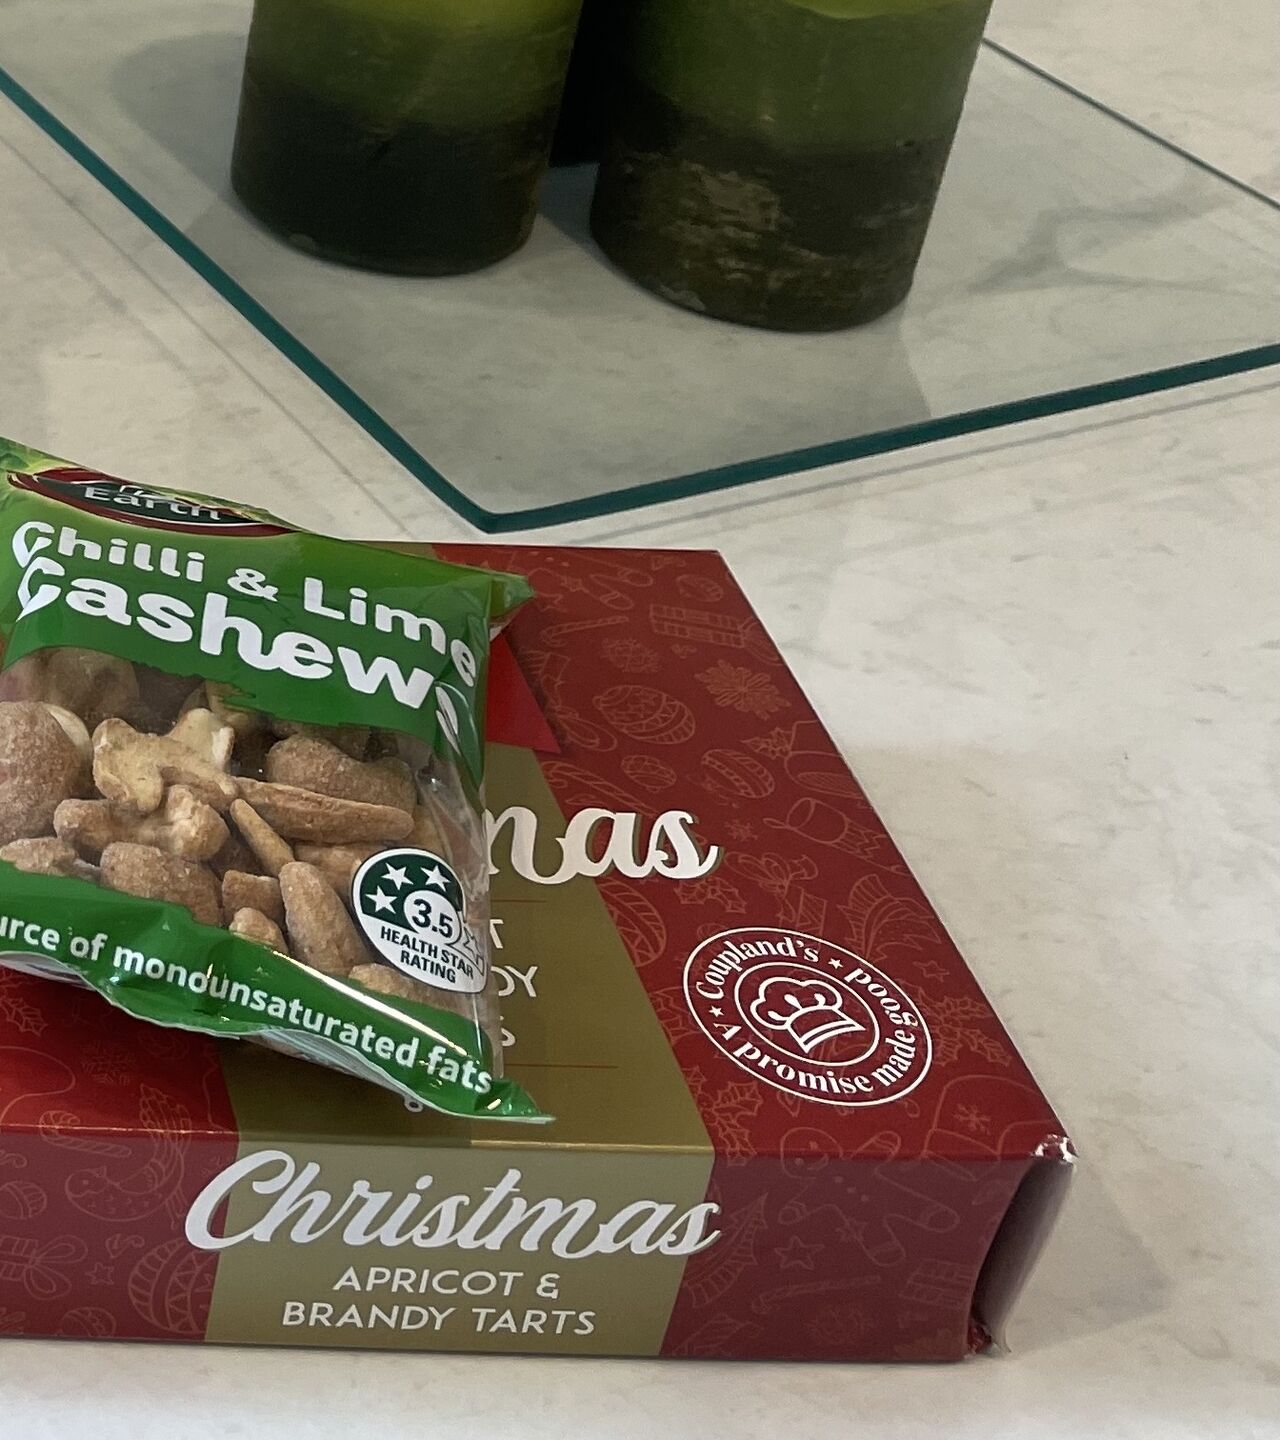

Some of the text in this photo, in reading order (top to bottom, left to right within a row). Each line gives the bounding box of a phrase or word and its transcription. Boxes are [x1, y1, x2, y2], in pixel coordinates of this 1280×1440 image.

[12, 520, 477, 687] Chilli & Lime
[412, 899, 454, 939] 3.5
[380, 925, 475, 980] HEALTH STAR
[400, 950, 456, 984] RATING
[696, 937, 819, 1000] Coupland's
[70, 933, 109, 962] of
[112, 945, 420, 1069] monounsaturated
[428, 1046, 494, 1095] fats
[713, 968, 919, 1094] A promise made good
[184, 1149, 722, 1260] Christmas
[332, 1265, 561, 1301] APRICOT &
[281, 1301, 597, 1337] BRANDY TARTS
